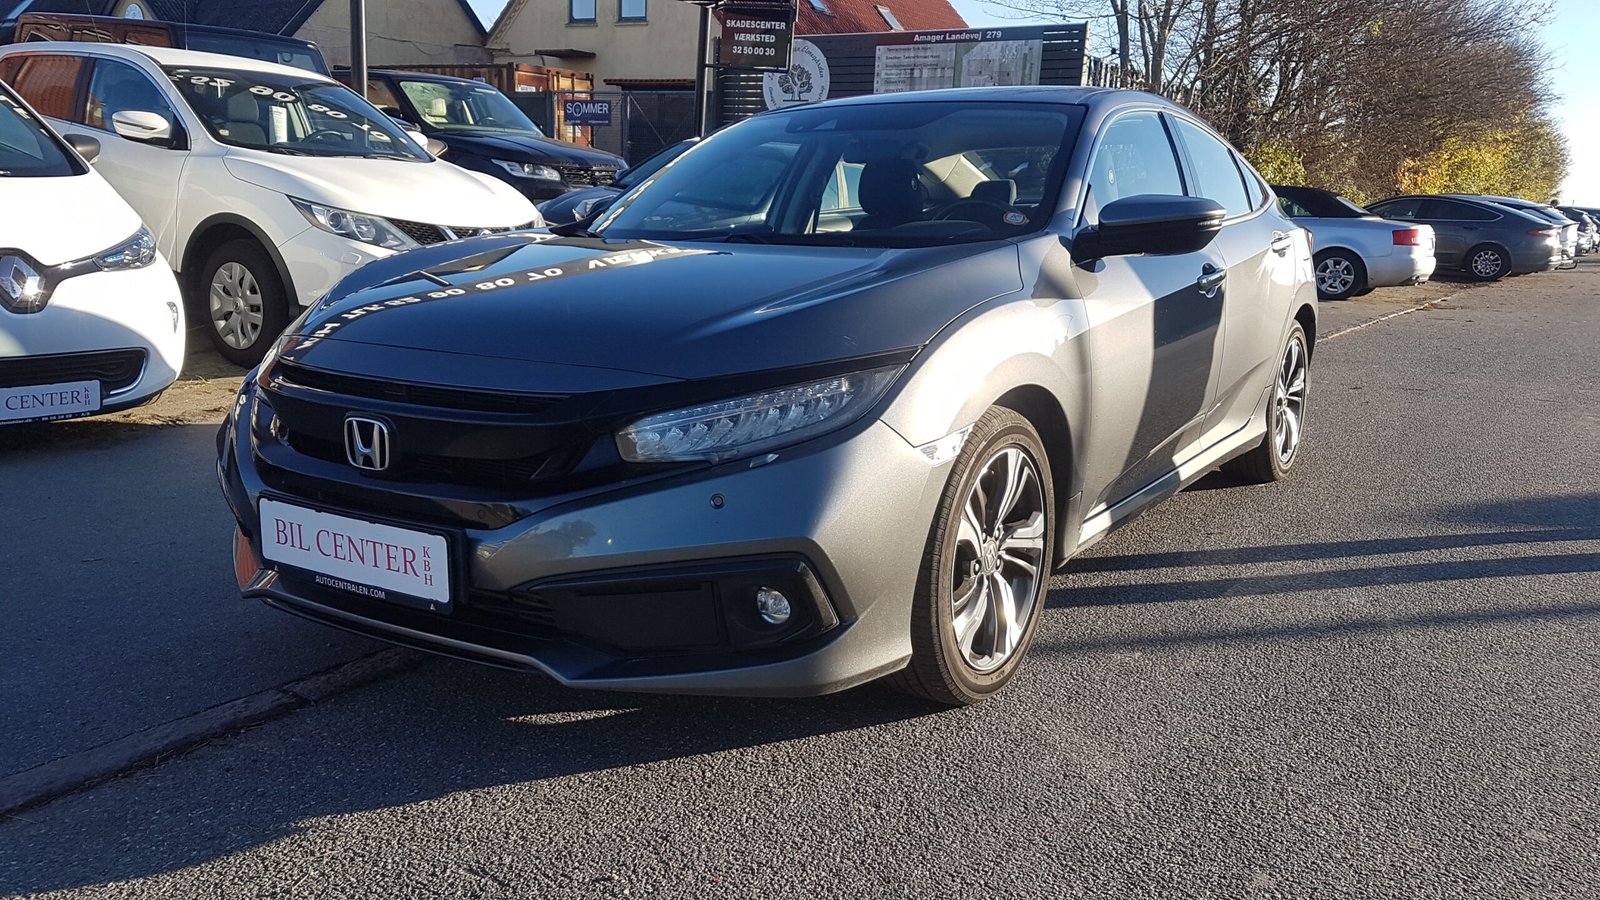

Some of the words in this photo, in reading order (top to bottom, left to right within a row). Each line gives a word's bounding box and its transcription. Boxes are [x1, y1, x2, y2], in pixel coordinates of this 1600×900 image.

[726, 20, 786, 30] SKADESCENTER
[734, 33, 776, 42] VÆRKSTED
[914, 34, 944, 43] Amager
[946, 32, 982, 41] Landevej
[986, 31, 1002, 39] 279
[732, 46, 742, 54] 32
[743, 46, 753, 55] 50
[754, 47, 764, 55] 00
[765, 48, 775, 56] 30
[566, 102, 609, 117] SOMMER
[5, 390, 82, 410] CENTER
[274, 518, 311, 552] BIL
[316, 529, 420, 578] CENTER
[422, 546, 433, 586] KBH
[315, 575, 386, 600] AUTOCENTRALEN.COM
